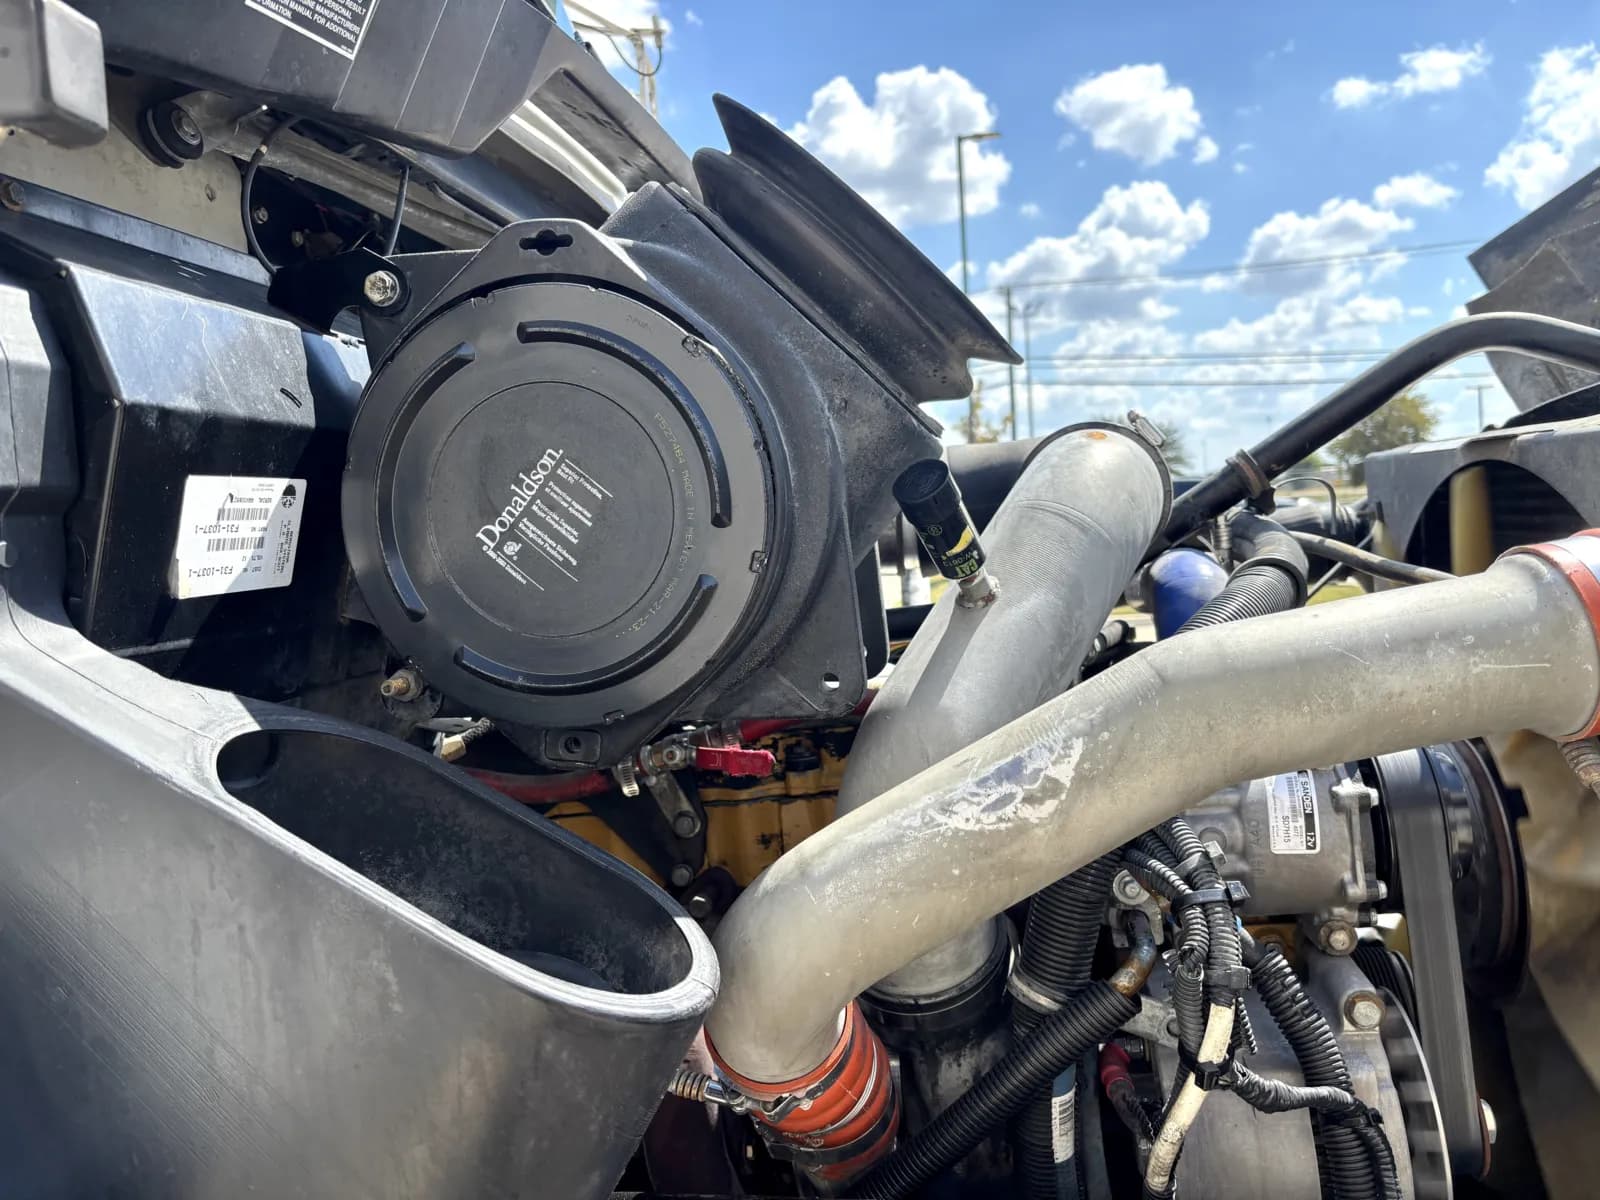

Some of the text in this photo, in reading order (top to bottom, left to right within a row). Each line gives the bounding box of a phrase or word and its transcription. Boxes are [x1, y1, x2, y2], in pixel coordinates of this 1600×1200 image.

[324, 0, 352, 20] PERSONAL
[345, 0, 366, 15] RESULT
[289, 0, 356, 43] MANUAL FOR ADDITIONAL
[315, 3, 360, 34] MANUFACTURERS
[195, 524, 240, 534] F31-1037-1
[188, 565, 234, 578] F31-1037-1
[954, 559, 978, 578] CAT
[1300, 781, 1312, 814] SANDEN
[1282, 816, 1291, 844] SD7H15
